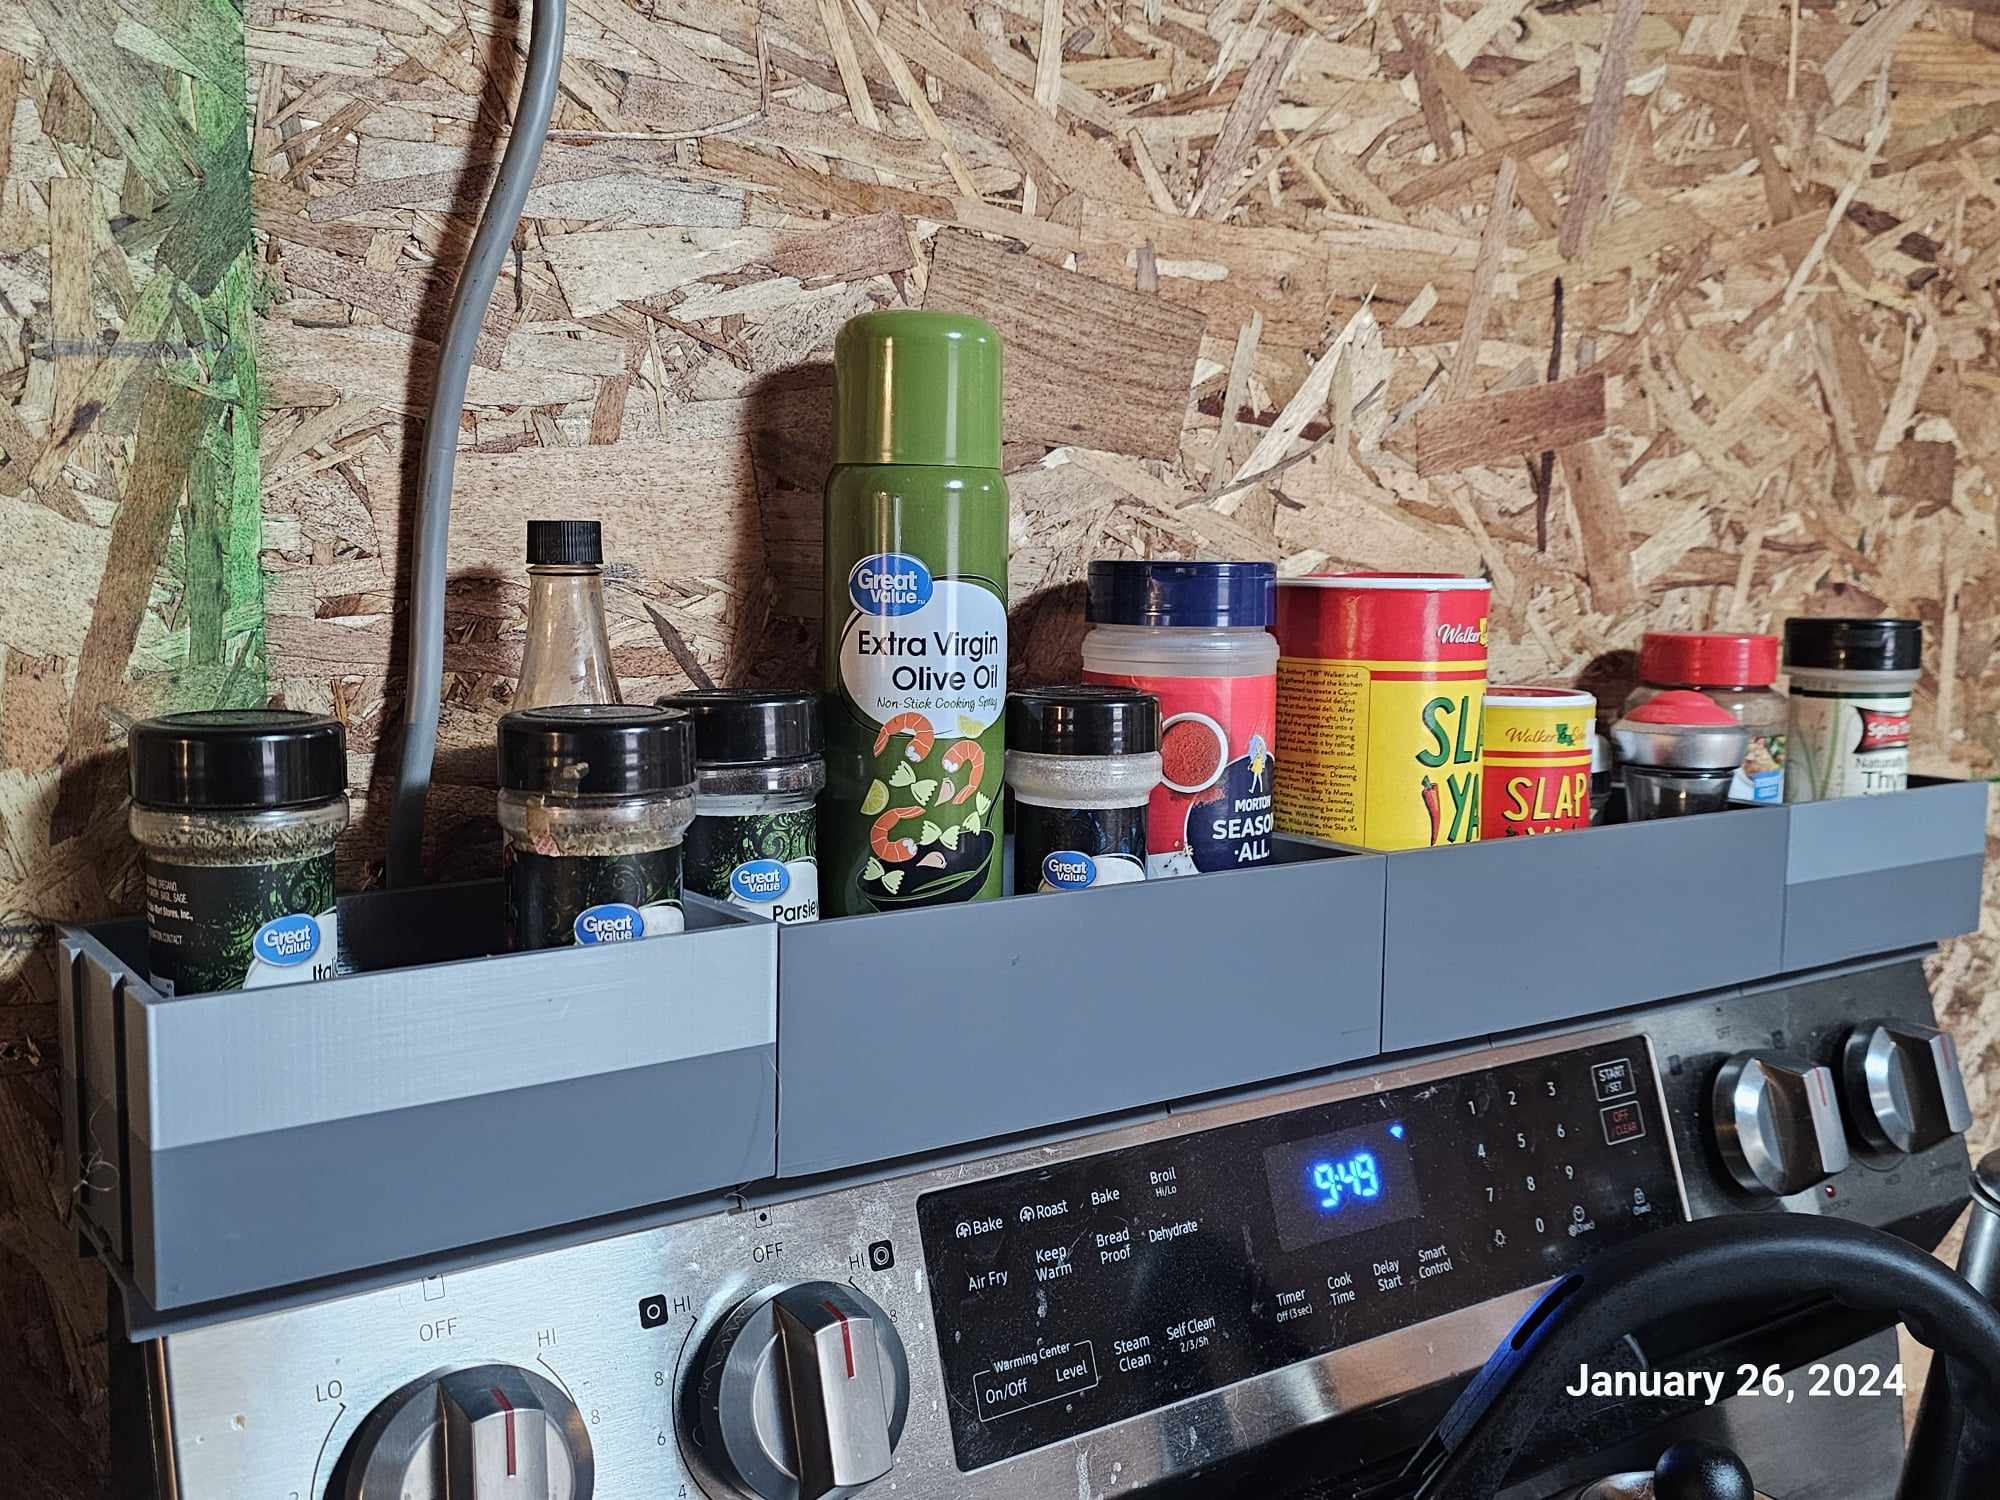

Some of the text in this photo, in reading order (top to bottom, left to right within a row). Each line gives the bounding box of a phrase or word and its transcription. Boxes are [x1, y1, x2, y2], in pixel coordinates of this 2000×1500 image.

[857, 568, 918, 591] Great
[870, 589, 917, 604] Value
[1437, 623, 1481, 645] Walke
[858, 630, 998, 662] Extra Virgin
[892, 665, 998, 691] Olive Oil
[877, 696, 932, 709] Non-Stick
[935, 697, 975, 712] Cooking
[1503, 772, 1589, 822] SLAP
[1048, 859, 1087, 874] Great
[738, 869, 780, 884] Great
[1057, 871, 1087, 882] Value
[748, 882, 781, 893] Value
[773, 899, 817, 922] Parsle
[583, 914, 633, 933] Great
[263, 924, 311, 947] Great
[595, 930, 633, 943] Value
[276, 941, 311, 956] Value
[313, 955, 337, 981] Ital
[1598, 1064, 1625, 1082] START
[1468, 1081, 1556, 1115] 1 2 3
[1477, 1123, 1566, 1158] 4 5 6
[1150, 1166, 1177, 1186] Broil
[1313, 1152, 1379, 1208] 9:49
[1486, 1165, 1574, 1202] 7 8 9
[1091, 1188, 1120, 1206] Bake
[1155, 1184, 1177, 1198] Hi/Lo
[1036, 1200, 1069, 1219] Roast
[973, 1216, 1003, 1235] Bake
[1149, 1219, 1198, 1243] Dehydrate
[1535, 1218, 1545, 1233] 0
[1096, 1227, 1130, 1248] Bread
[752, 1242, 784, 1263] OFF
[849, 1254, 866, 1270] HI
[1036, 1245, 1067, 1264] Keep
[1100, 1244, 1131, 1265] Proof
[1418, 1244, 1447, 1263] Smart
[1035, 1262, 1073, 1283] Warm
[1373, 1259, 1400, 1279] Delay
[1418, 1258, 1453, 1280] Control
[968, 1270, 1008, 1292] Air Fry
[1327, 1272, 1353, 1290] Cook
[1377, 1275, 1402, 1293] Start
[674, 1296, 691, 1313] HI
[1276, 1288, 1306, 1307] Timer
[1330, 1289, 1356, 1306] Time
[889, 1310, 898, 1324] 8
[1276, 1310, 1289, 1322] Off
[419, 1317, 458, 1342] OFF
[537, 1328, 557, 1347] HI
[1166, 1315, 1216, 1341] Self Clean
[1114, 1334, 1150, 1355] Steam
[1180, 1336, 1209, 1353] 2/3/5h
[993, 1342, 1071, 1374] Warming Center
[1119, 1353, 1151, 1373] Clean
[655, 1371, 664, 1386] 8
[985, 1360, 1088, 1404] On/Off Level
[315, 1380, 343, 1403] LO
[592, 1409, 601, 1425] 8
[658, 1431, 666, 1446] 6
[679, 1484, 687, 1500] 4
